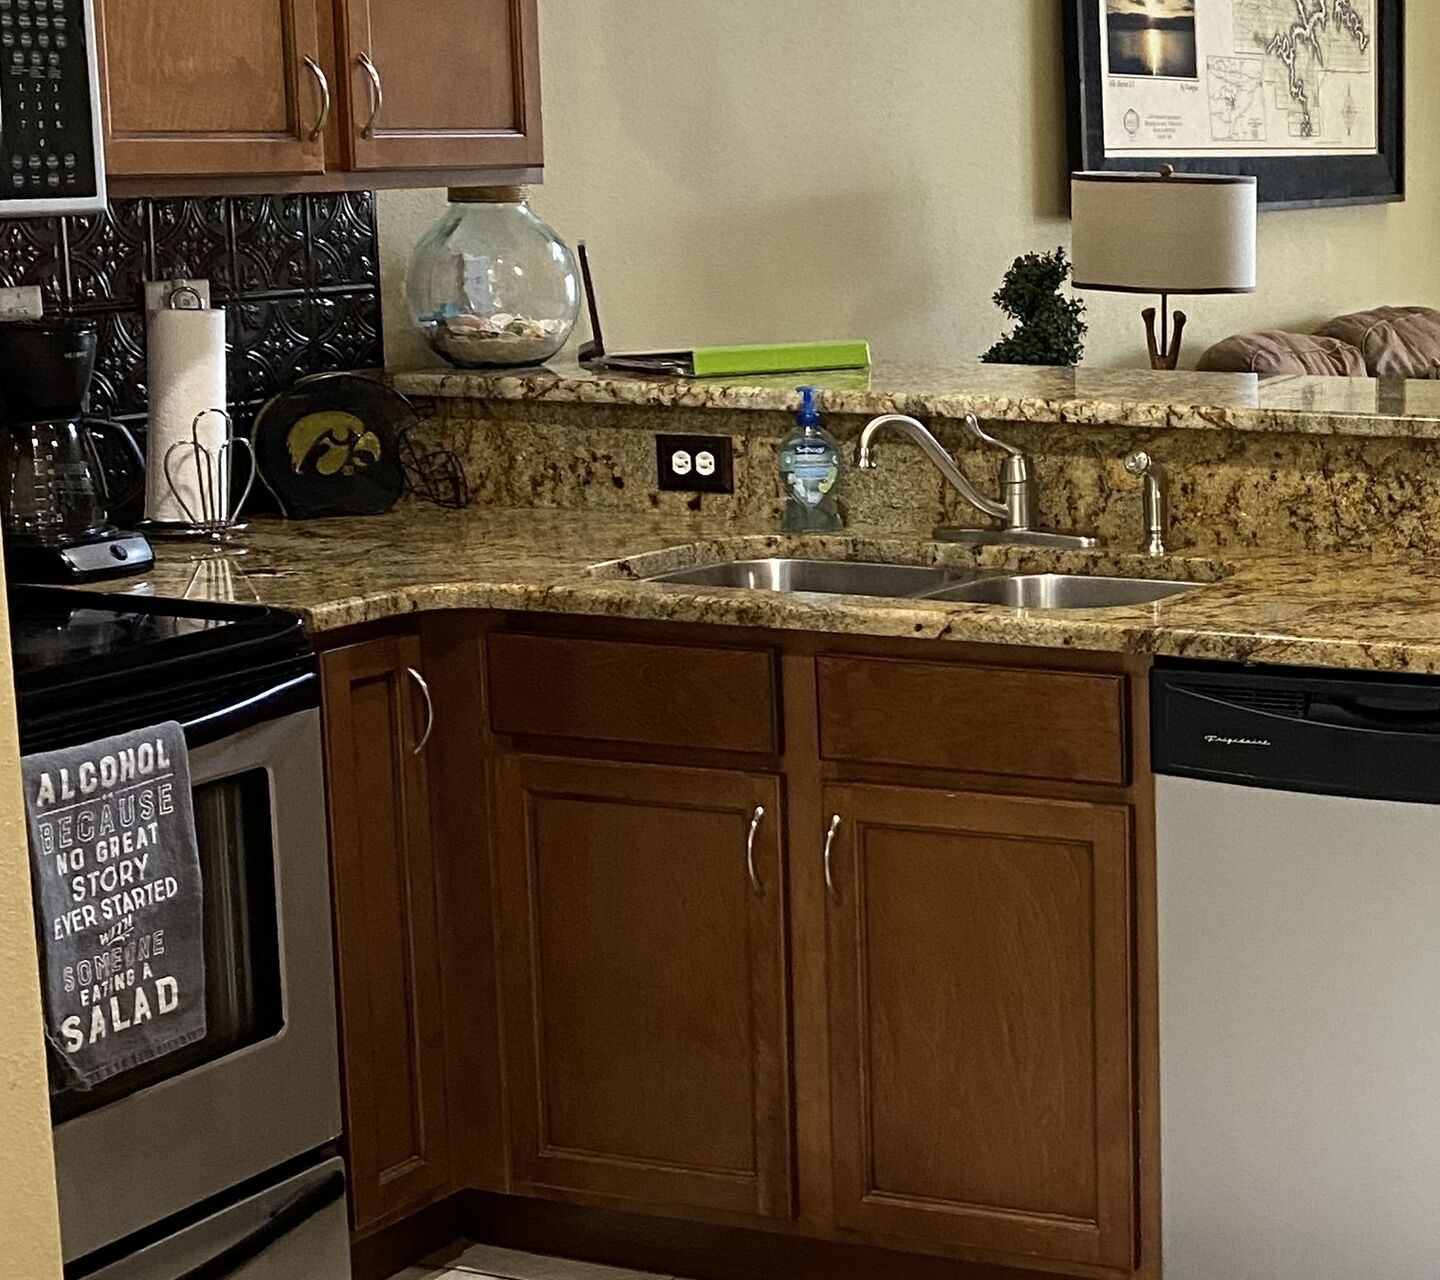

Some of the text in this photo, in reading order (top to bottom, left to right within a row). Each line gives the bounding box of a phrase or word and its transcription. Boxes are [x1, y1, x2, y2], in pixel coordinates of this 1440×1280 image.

[36, 738, 171, 807] ALCOHOL
[39, 783, 174, 855] BECAUSE
[56, 822, 158, 876] NO GREAT
[54, 876, 178, 941] EVER STARTED
[72, 853, 149, 902] STORY
[62, 929, 165, 992] SOMEONE
[80, 962, 153, 1007] EATING A
[61, 976, 178, 1053] SALAD
